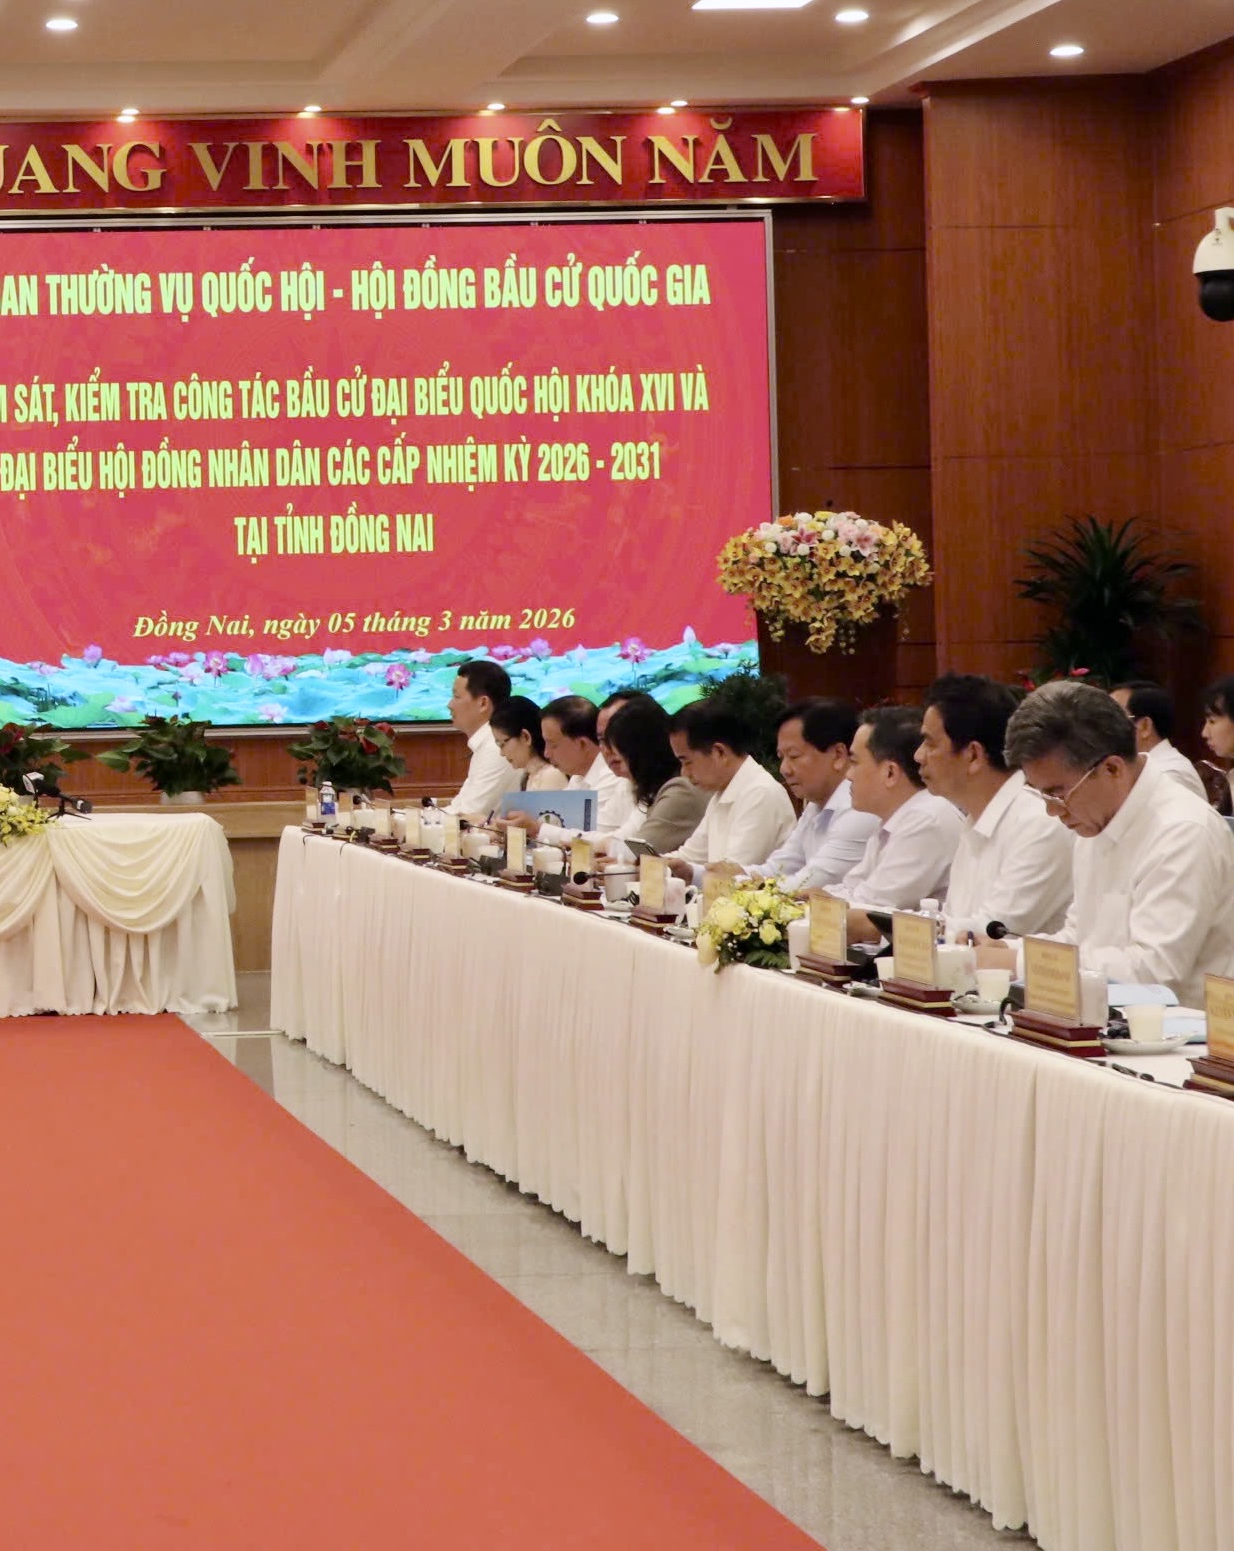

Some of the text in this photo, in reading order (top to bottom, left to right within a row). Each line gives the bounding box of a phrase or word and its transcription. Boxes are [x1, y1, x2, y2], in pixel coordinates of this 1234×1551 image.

[188, 138, 383, 192] VINH
[402, 118, 627, 188] MUÔN
[647, 117, 819, 184] NĂM
[44, 262, 153, 316] THƯỜNG
[158, 271, 194, 323] VỤ
[201, 256, 273, 318] QUỐC
[279, 261, 326, 321] HỘI
[332, 288, 344, 299] -
[350, 260, 396, 320] HỘI
[402, 254, 477, 311] ĐỒNG
[483, 252, 538, 309] BẦU
[544, 252, 584, 308] CỬ
[587, 250, 659, 312] QUỐC
[665, 263, 711, 306] GIA
[13, 375, 59, 428] SÁT,
[64, 366, 121, 423] KIỂM
[125, 381, 168, 421] TRA
[172, 372, 234, 421] CÔNG
[238, 371, 281, 419] TÁC
[285, 365, 331, 419] BẦU
[336, 364, 368, 418] CỬ
[370, 377, 408, 426] ĐẠI
[413, 360, 464, 416] BIỂU
[469, 361, 528, 420] QUỐC
[533, 366, 571, 423] HỘI
[575, 365, 635, 413] KHÓA
[639, 372, 675, 412] XVI
[679, 363, 710, 412] VÀ
[42, 435, 94, 492] BIỂU
[98, 441, 136, 499] HỘI
[140, 436, 203, 490] ĐỒNG
[207, 439, 270, 488] NHÂN
[275, 439, 321, 487] DÂN
[326, 438, 371, 487] CÁC
[376, 431, 421, 486] CẤP
[426, 435, 498, 492] NHIỆM
[503, 434, 532, 483] KỲ
[537, 442, 591, 482] 2026
[595, 459, 605, 469] -
[610, 440, 661, 481] 2031
[233, 500, 434, 565] TẠI TỈNH ĐỒNG NAI
[132, 607, 576, 643] Đồng Nai, ngày 05 tháng 3 năm 2026
